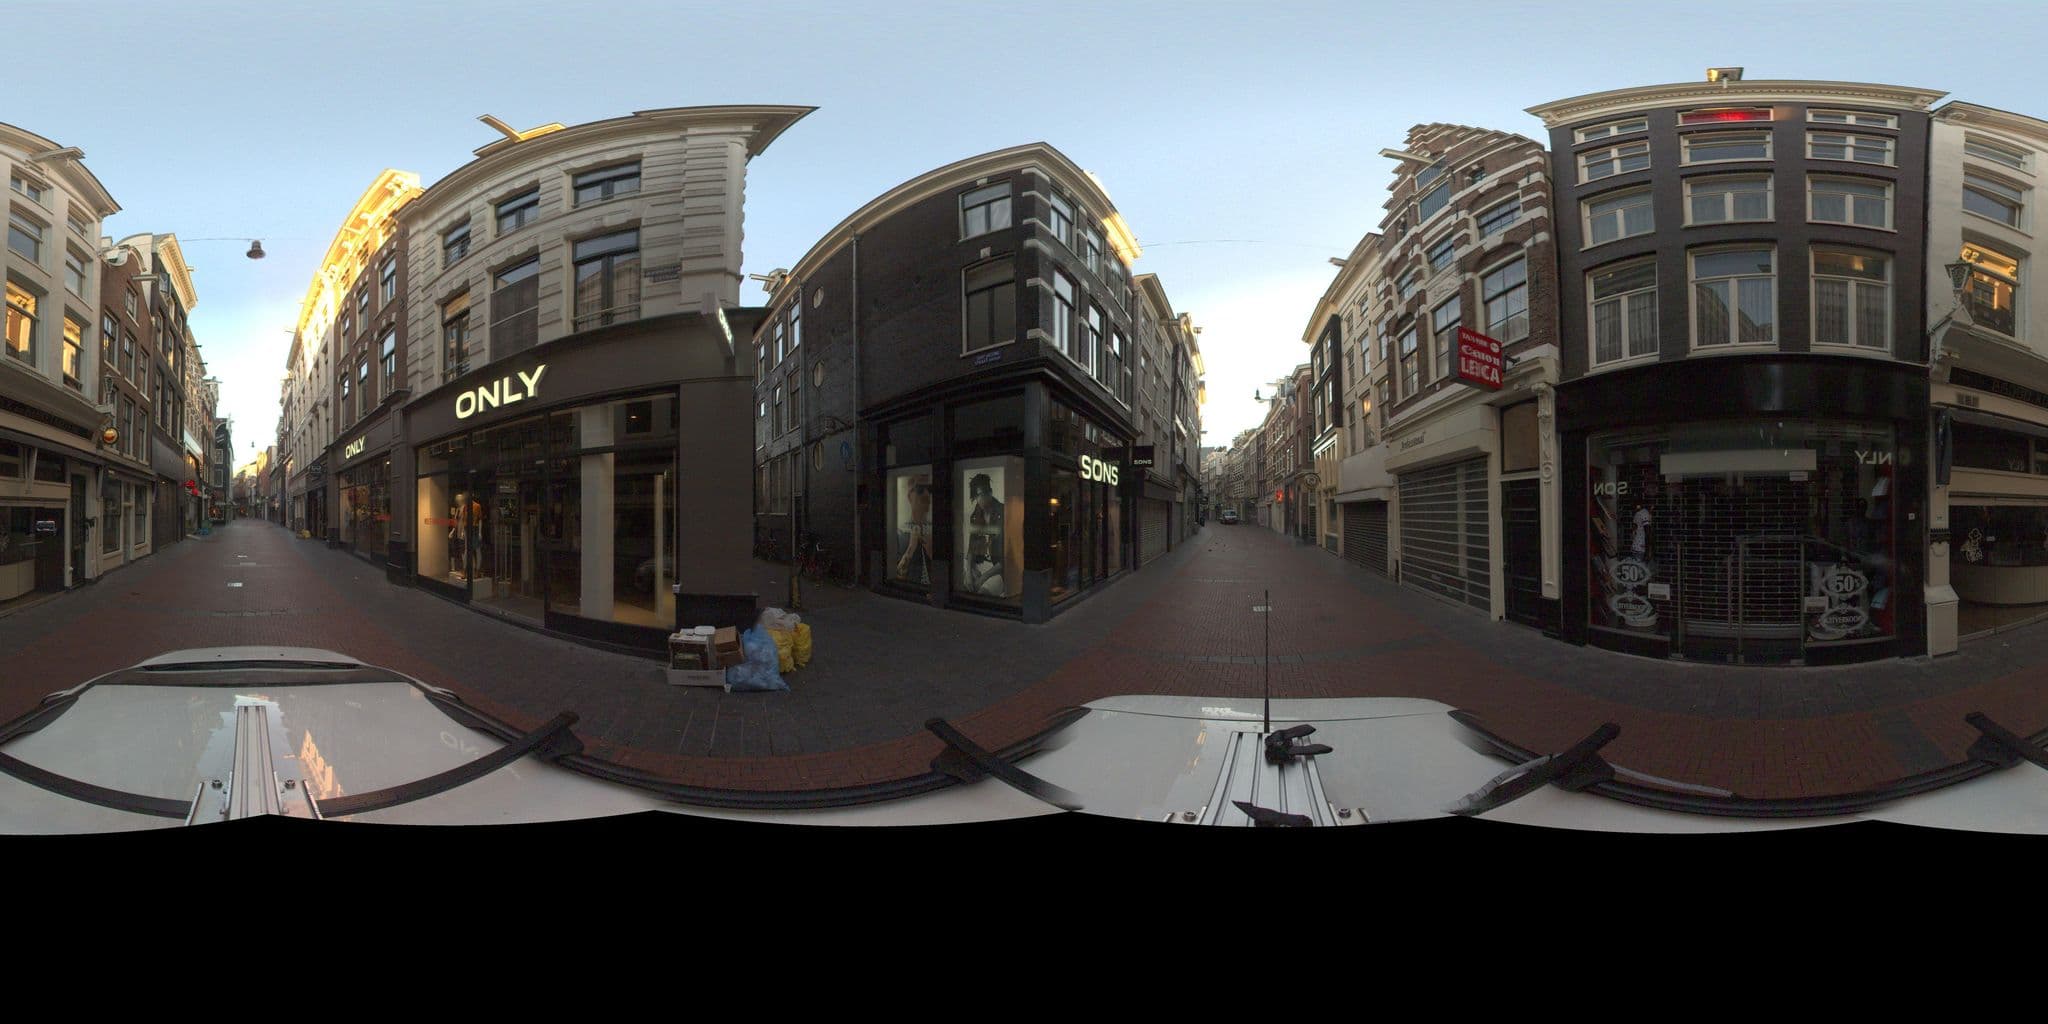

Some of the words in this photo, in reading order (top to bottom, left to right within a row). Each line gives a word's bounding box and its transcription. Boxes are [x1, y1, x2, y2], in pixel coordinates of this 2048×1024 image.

[1461, 344, 1500, 365] Canon
[1461, 356, 1500, 384] LEICA
[456, 364, 546, 419] ONLY
[345, 435, 366, 459] ONLY
[1080, 454, 1119, 486] SONS
